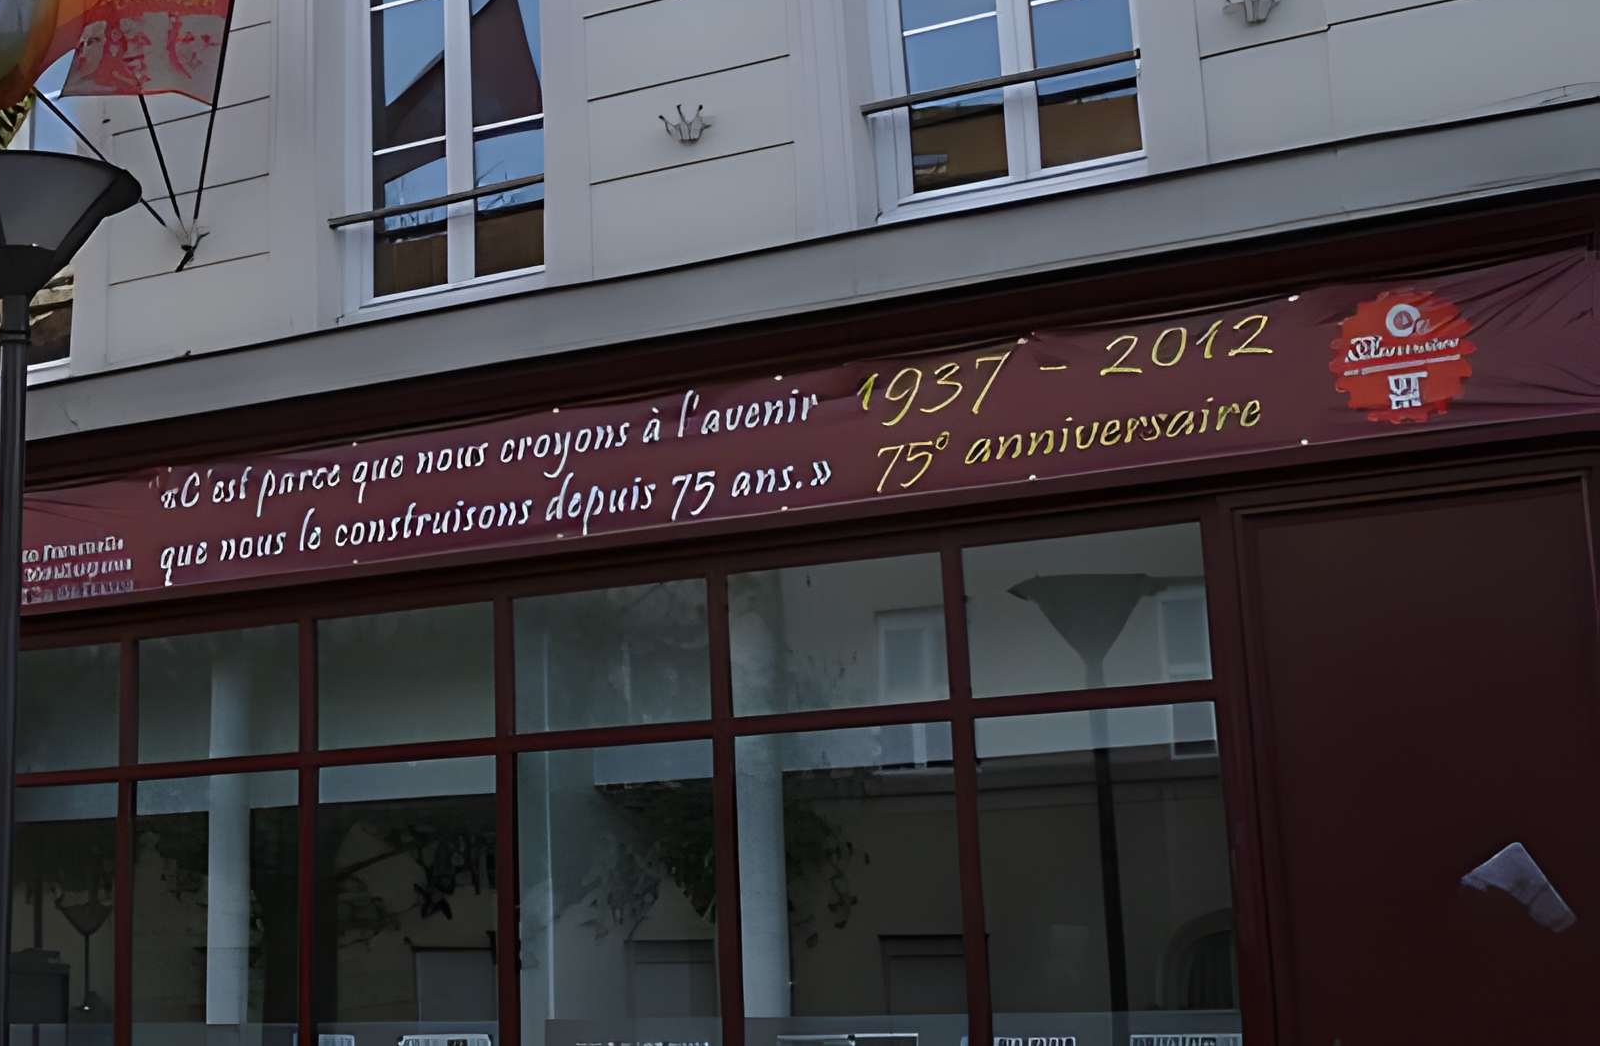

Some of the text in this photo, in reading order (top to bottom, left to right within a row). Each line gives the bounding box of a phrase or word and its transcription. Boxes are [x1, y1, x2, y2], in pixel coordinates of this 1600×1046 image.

[856, 351, 1011, 427] 1937
[1100, 315, 1274, 376] 2012
[256, 464, 341, 518] parce
[352, 455, 404, 504] que
[416, 442, 489, 475] nous
[500, 422, 630, 478] croyons
[642, 408, 660, 443] à
[677, 389, 818, 438] l'avenir
[964, 397, 1261, 466] anniversaire
[160, 542, 208, 587] que
[219, 531, 288, 562] nous
[299, 507, 322, 552] le
[335, 498, 532, 547] construisons
[545, 472, 656, 536] depuis
[671, 470, 716, 522] 75
